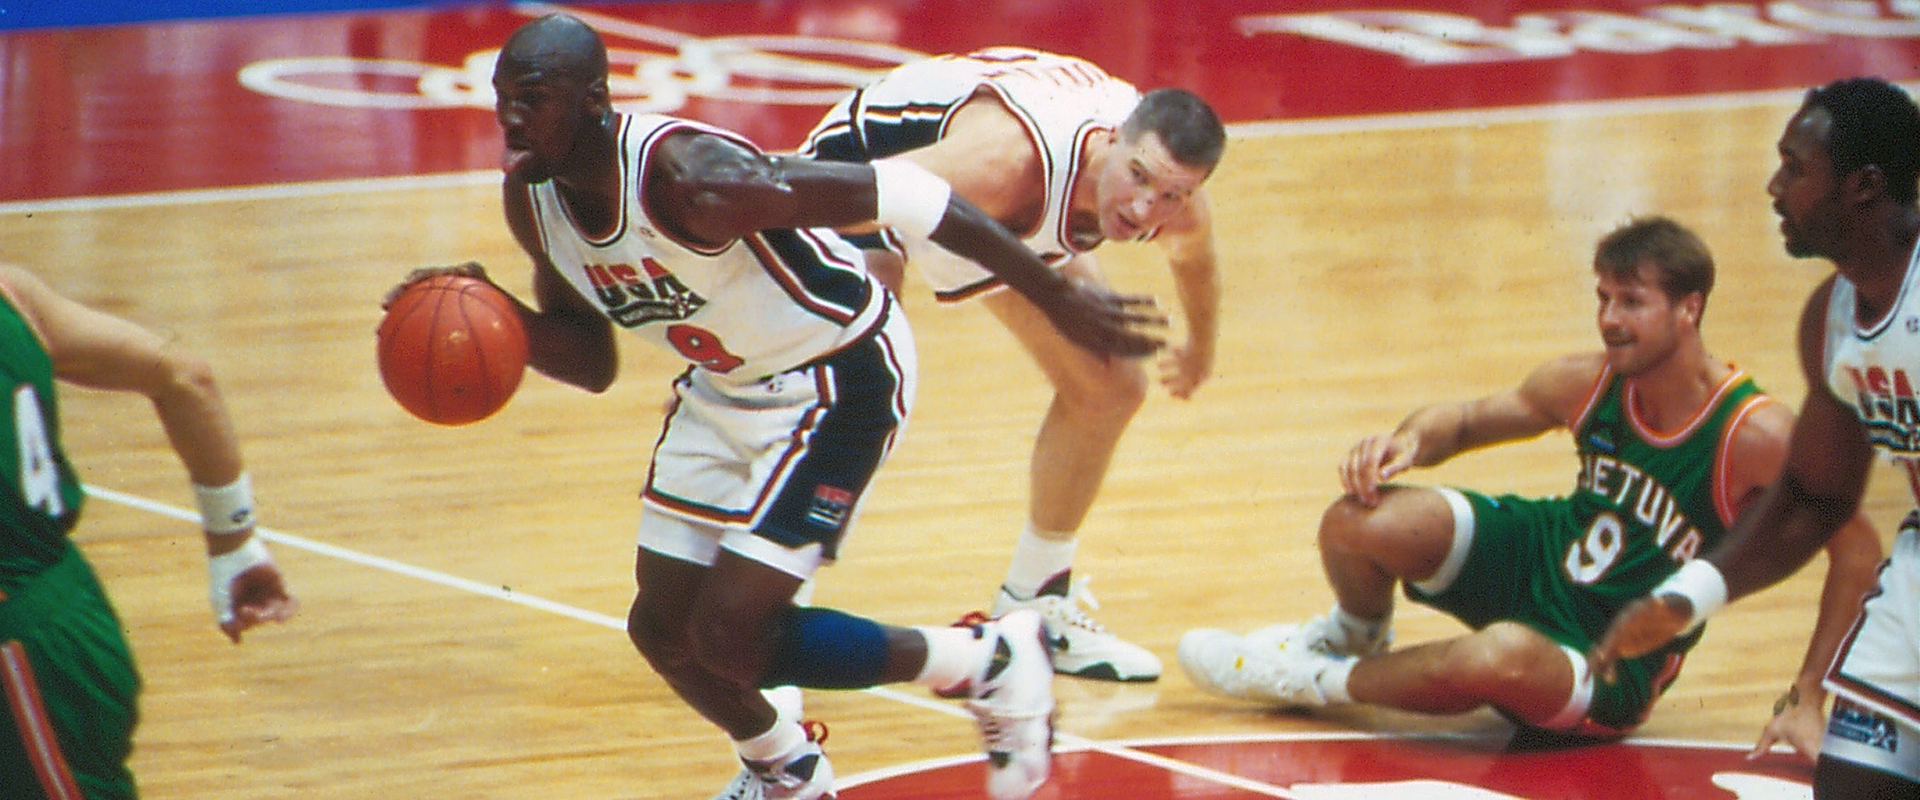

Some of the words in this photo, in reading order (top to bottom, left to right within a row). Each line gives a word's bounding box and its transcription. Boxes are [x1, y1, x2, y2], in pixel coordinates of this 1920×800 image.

[1236, 0, 1920, 64] Barc
[583, 256, 692, 308] USA
[666, 323, 746, 374] 9
[1580, 455, 1703, 563] IETUVA
[1563, 513, 1624, 583] 9
